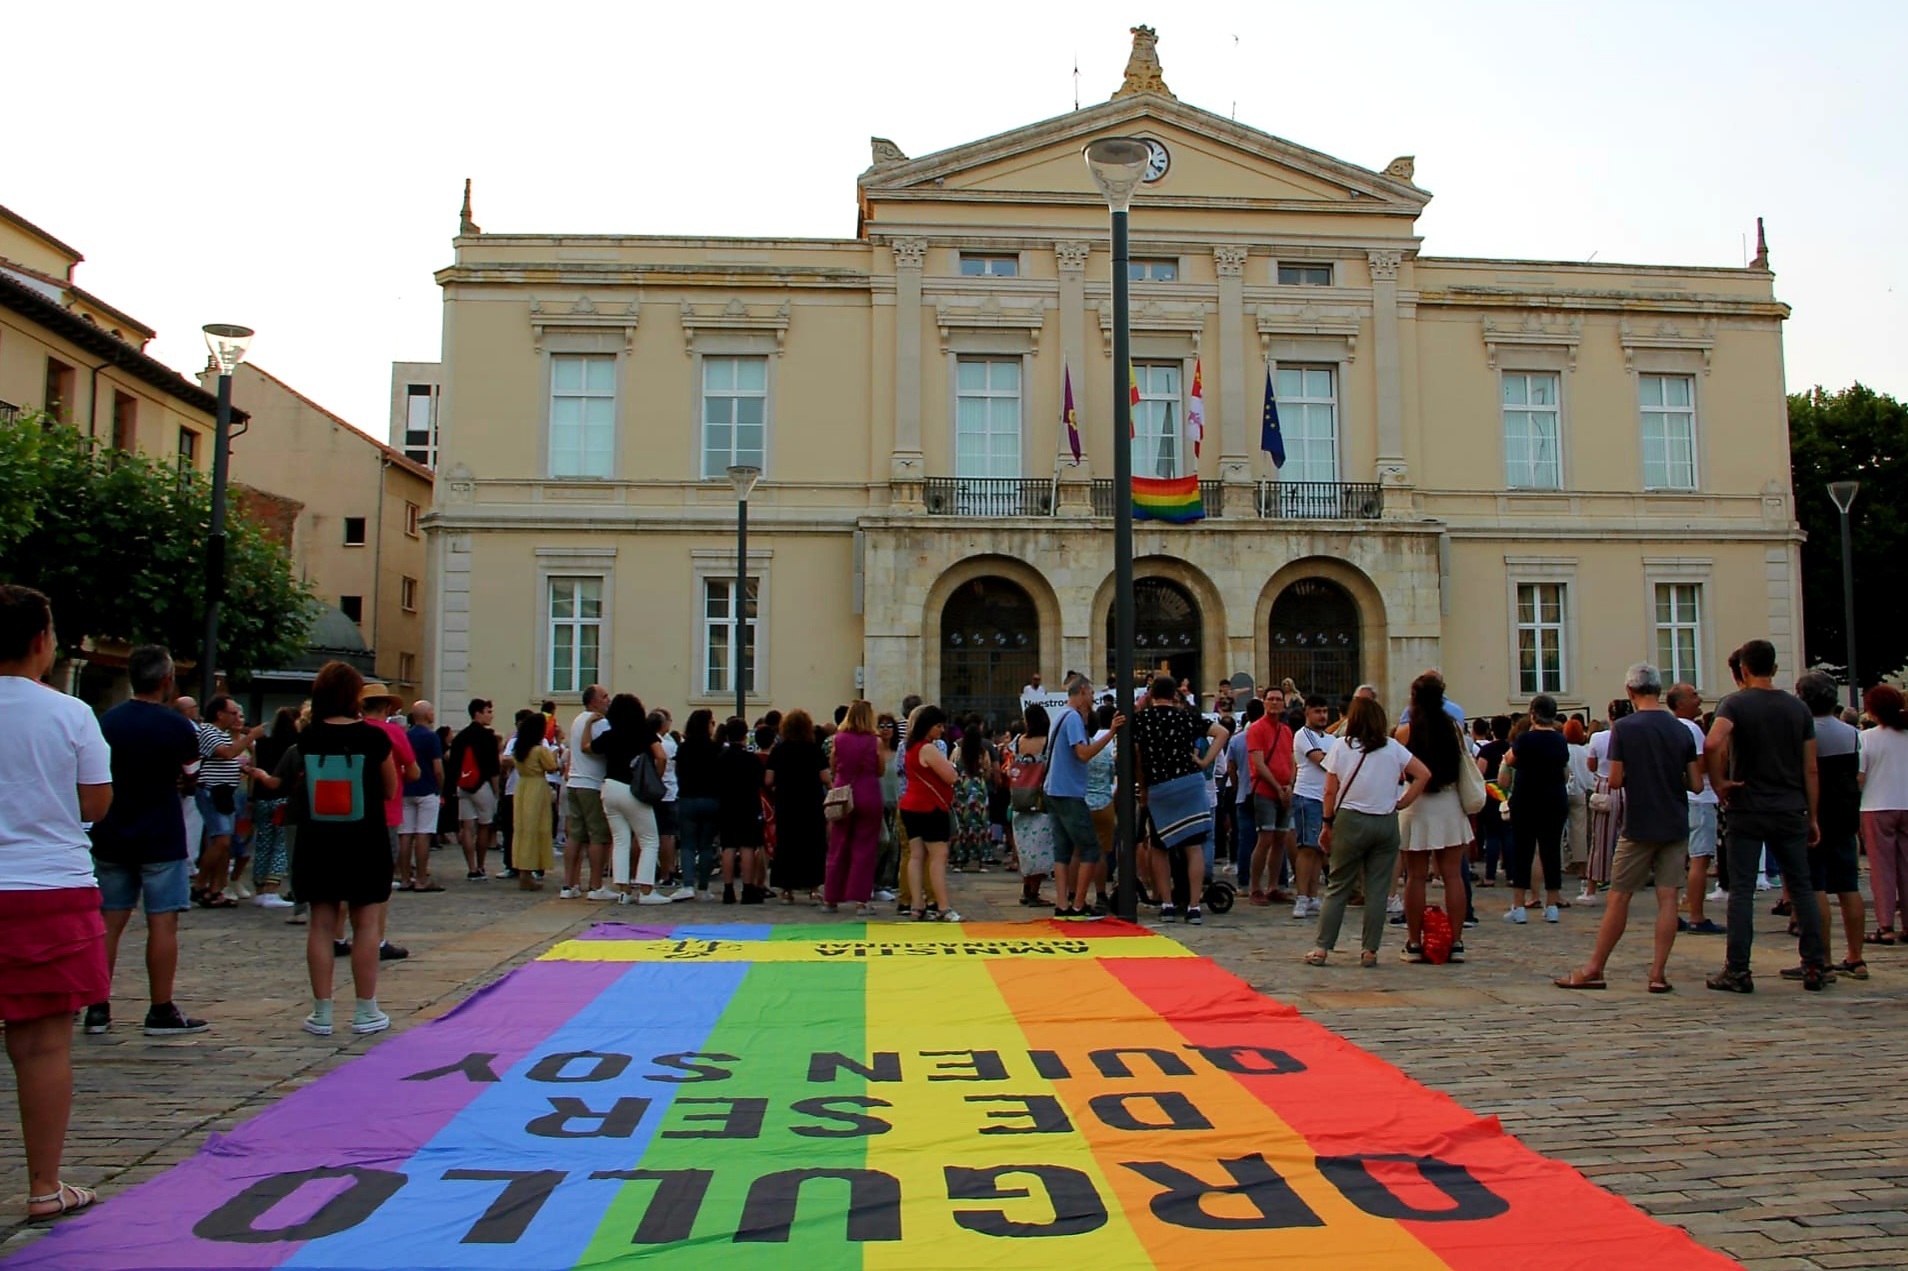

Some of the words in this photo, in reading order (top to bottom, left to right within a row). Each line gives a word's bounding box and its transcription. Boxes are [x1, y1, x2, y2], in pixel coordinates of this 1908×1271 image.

[399, 1050, 743, 1083] SOY
[806, 1043, 1308, 1083] QUIEN
[525, 1094, 893, 1140] SER
[963, 1091, 1215, 1136] DE
[192, 1151, 1511, 1245] ORGULLO
